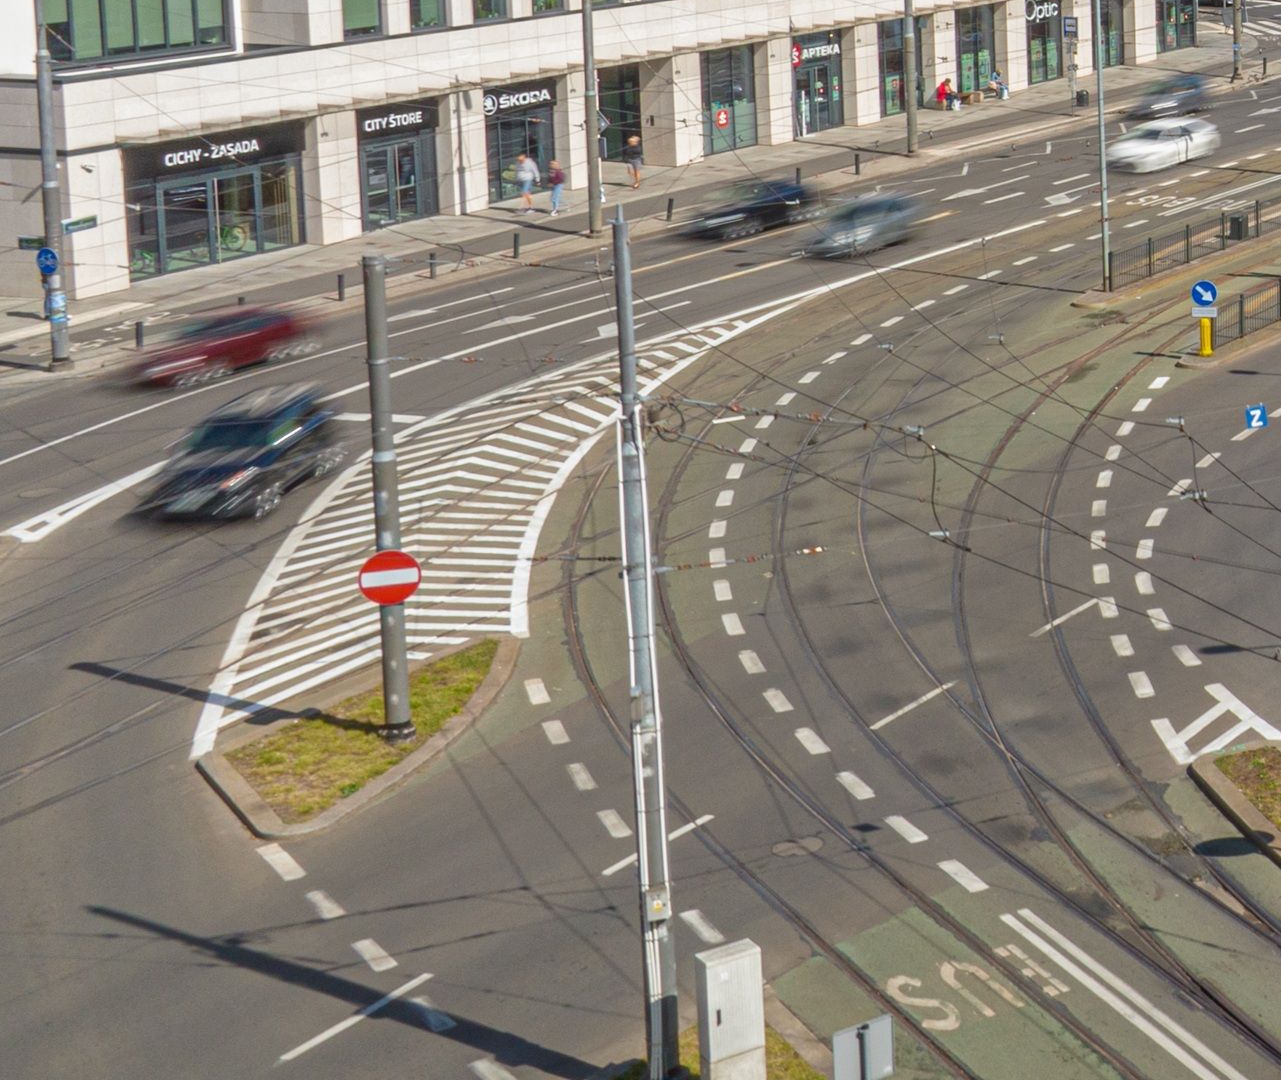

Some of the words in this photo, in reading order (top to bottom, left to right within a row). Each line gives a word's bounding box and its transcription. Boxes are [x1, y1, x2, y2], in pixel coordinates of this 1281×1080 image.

[1025, 0, 1058, 23] Optic
[802, 43, 840, 60] APTEKA
[499, 88, 551, 109] ŠKODA
[364, 117, 388, 132] CITY
[164, 149, 202, 167] CICHY
